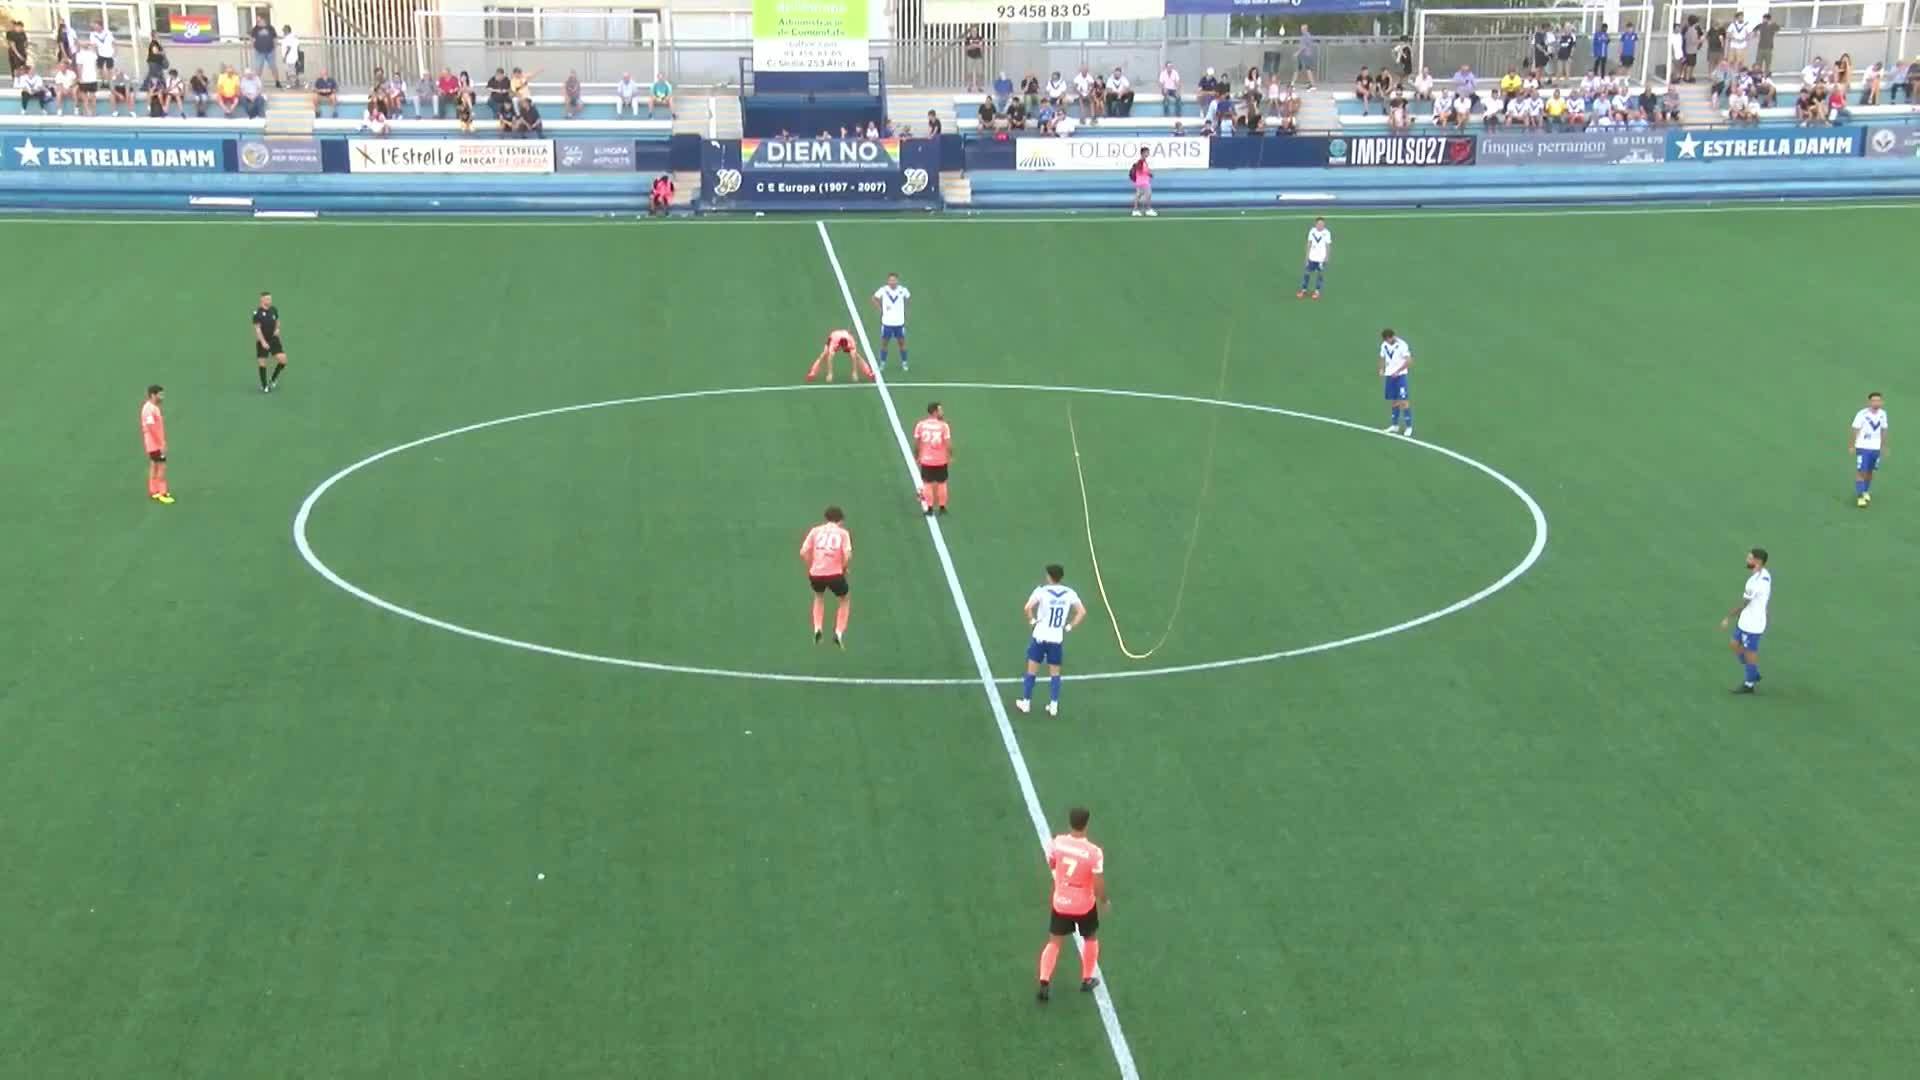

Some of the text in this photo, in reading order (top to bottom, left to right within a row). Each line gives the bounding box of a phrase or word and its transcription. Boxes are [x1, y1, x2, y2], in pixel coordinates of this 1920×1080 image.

[997, 3, 1090, 18] 93 458 83 05
[767, 142, 878, 161] DIEM NO
[1068, 142, 1201, 159] TOLDOARIS
[1351, 137, 1447, 165] IMPULSO27
[1482, 140, 1606, 157] finques perramon
[1703, 136, 1852, 157] ESTRELLA DAMM
[48, 147, 215, 167] ESTRELLA DAMM
[460, 157, 496, 165] MERCAT
[756, 183, 763, 192] C
[778, 183, 816, 193] Europa
[819, 182, 847, 193] (1907
[858, 182, 886, 193] 2007)
[816, 531, 841, 549] 20
[1049, 607, 1063, 628] 18
[1062, 857, 1077, 877] 7
